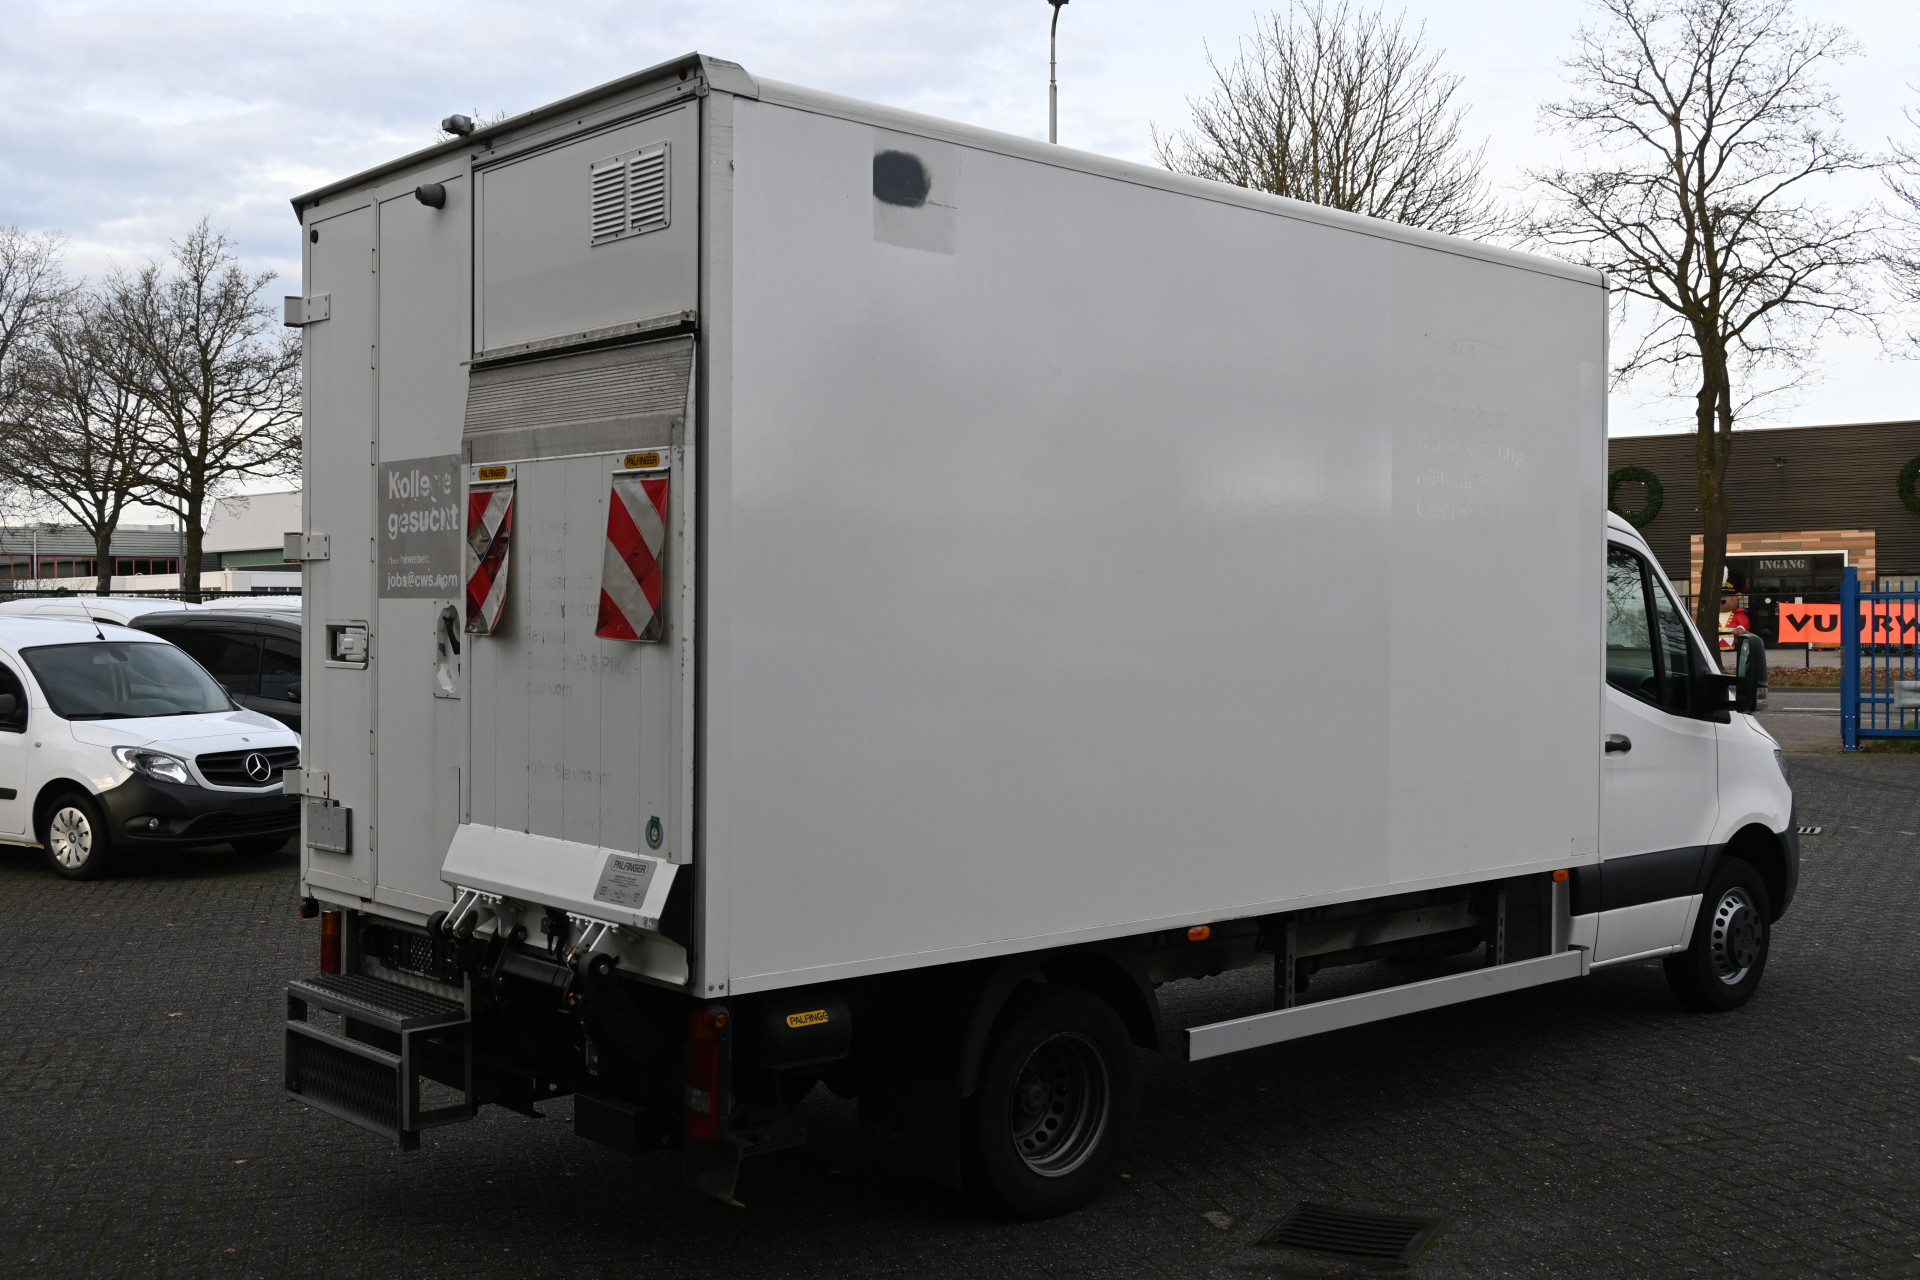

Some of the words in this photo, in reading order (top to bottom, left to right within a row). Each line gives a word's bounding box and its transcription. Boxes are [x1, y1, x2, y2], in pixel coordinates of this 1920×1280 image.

[626, 455, 658, 466] PALFINGER
[480, 468, 506, 478] PALFINGER
[388, 469, 452, 500] Kollee
[388, 503, 459, 540] gesucht
[1759, 559, 1805, 570] INGANG
[1785, 613, 1920, 634] VURW
[613, 859, 647, 874] PALFINGER
